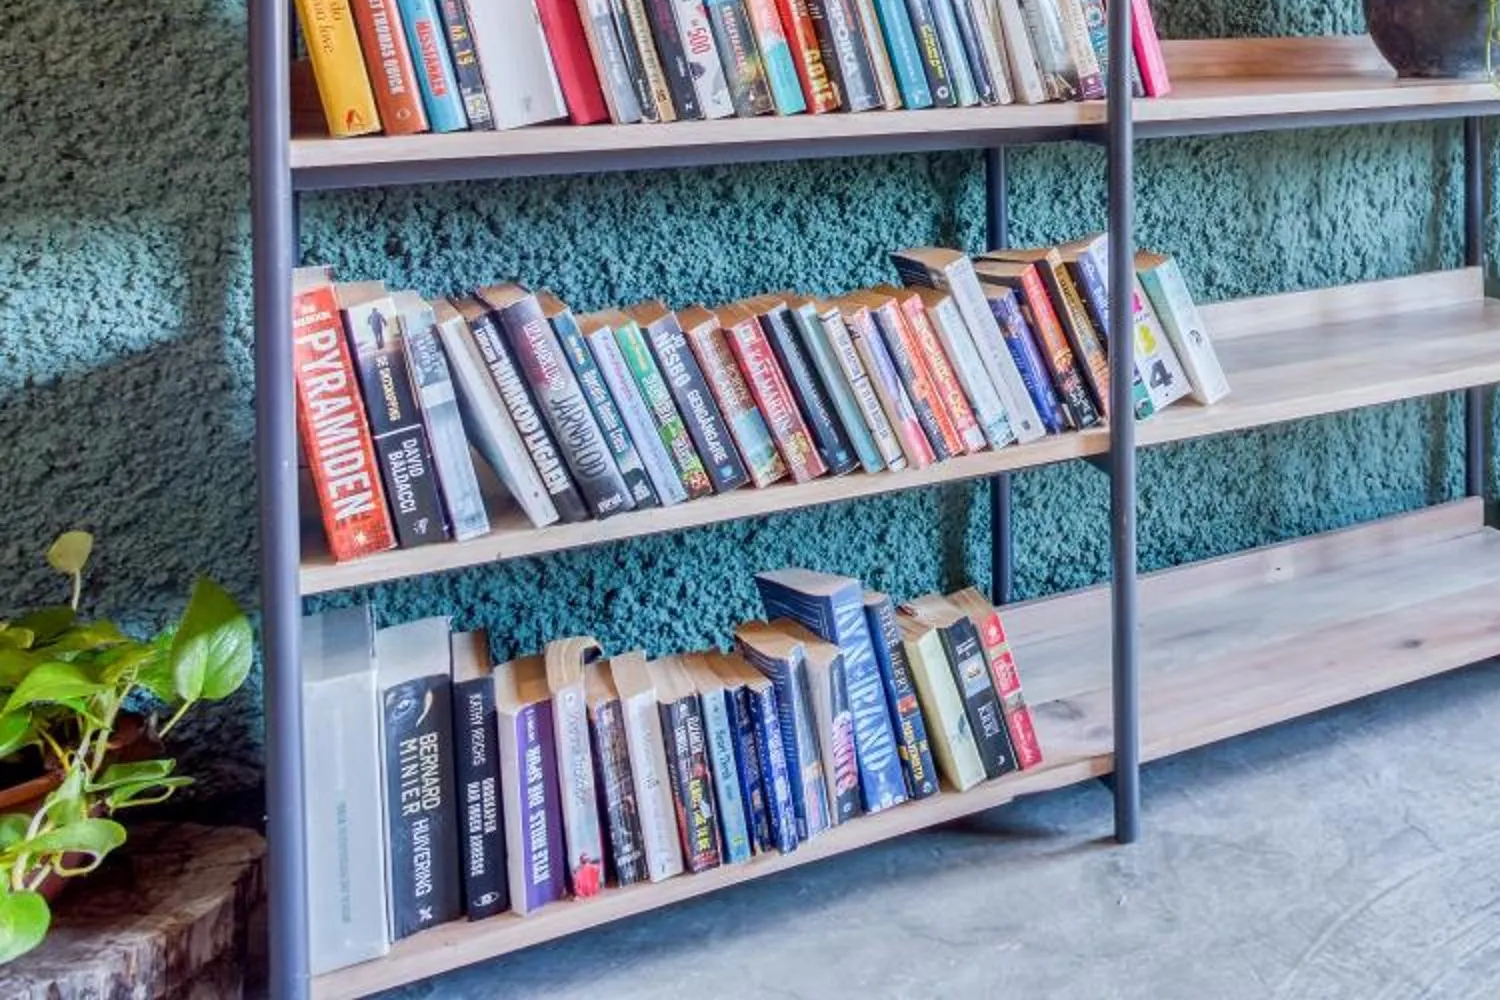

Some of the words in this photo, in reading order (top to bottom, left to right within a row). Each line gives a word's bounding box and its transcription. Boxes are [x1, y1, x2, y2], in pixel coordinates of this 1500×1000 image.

[1150, 359, 1173, 389] 4
[293, 327, 378, 521] PYRAMIDEN
[401, 438, 426, 478] DAVID
[386, 450, 418, 515] BALDACCI
[877, 605, 899, 649] STEVE
[889, 650, 911, 696] BERRY
[468, 693, 484, 726] KATHY
[847, 672, 898, 773] RAND
[399, 738, 422, 817] MINIER
[418, 732, 442, 810] BERNARD
[412, 817, 433, 897] HUIVERING
